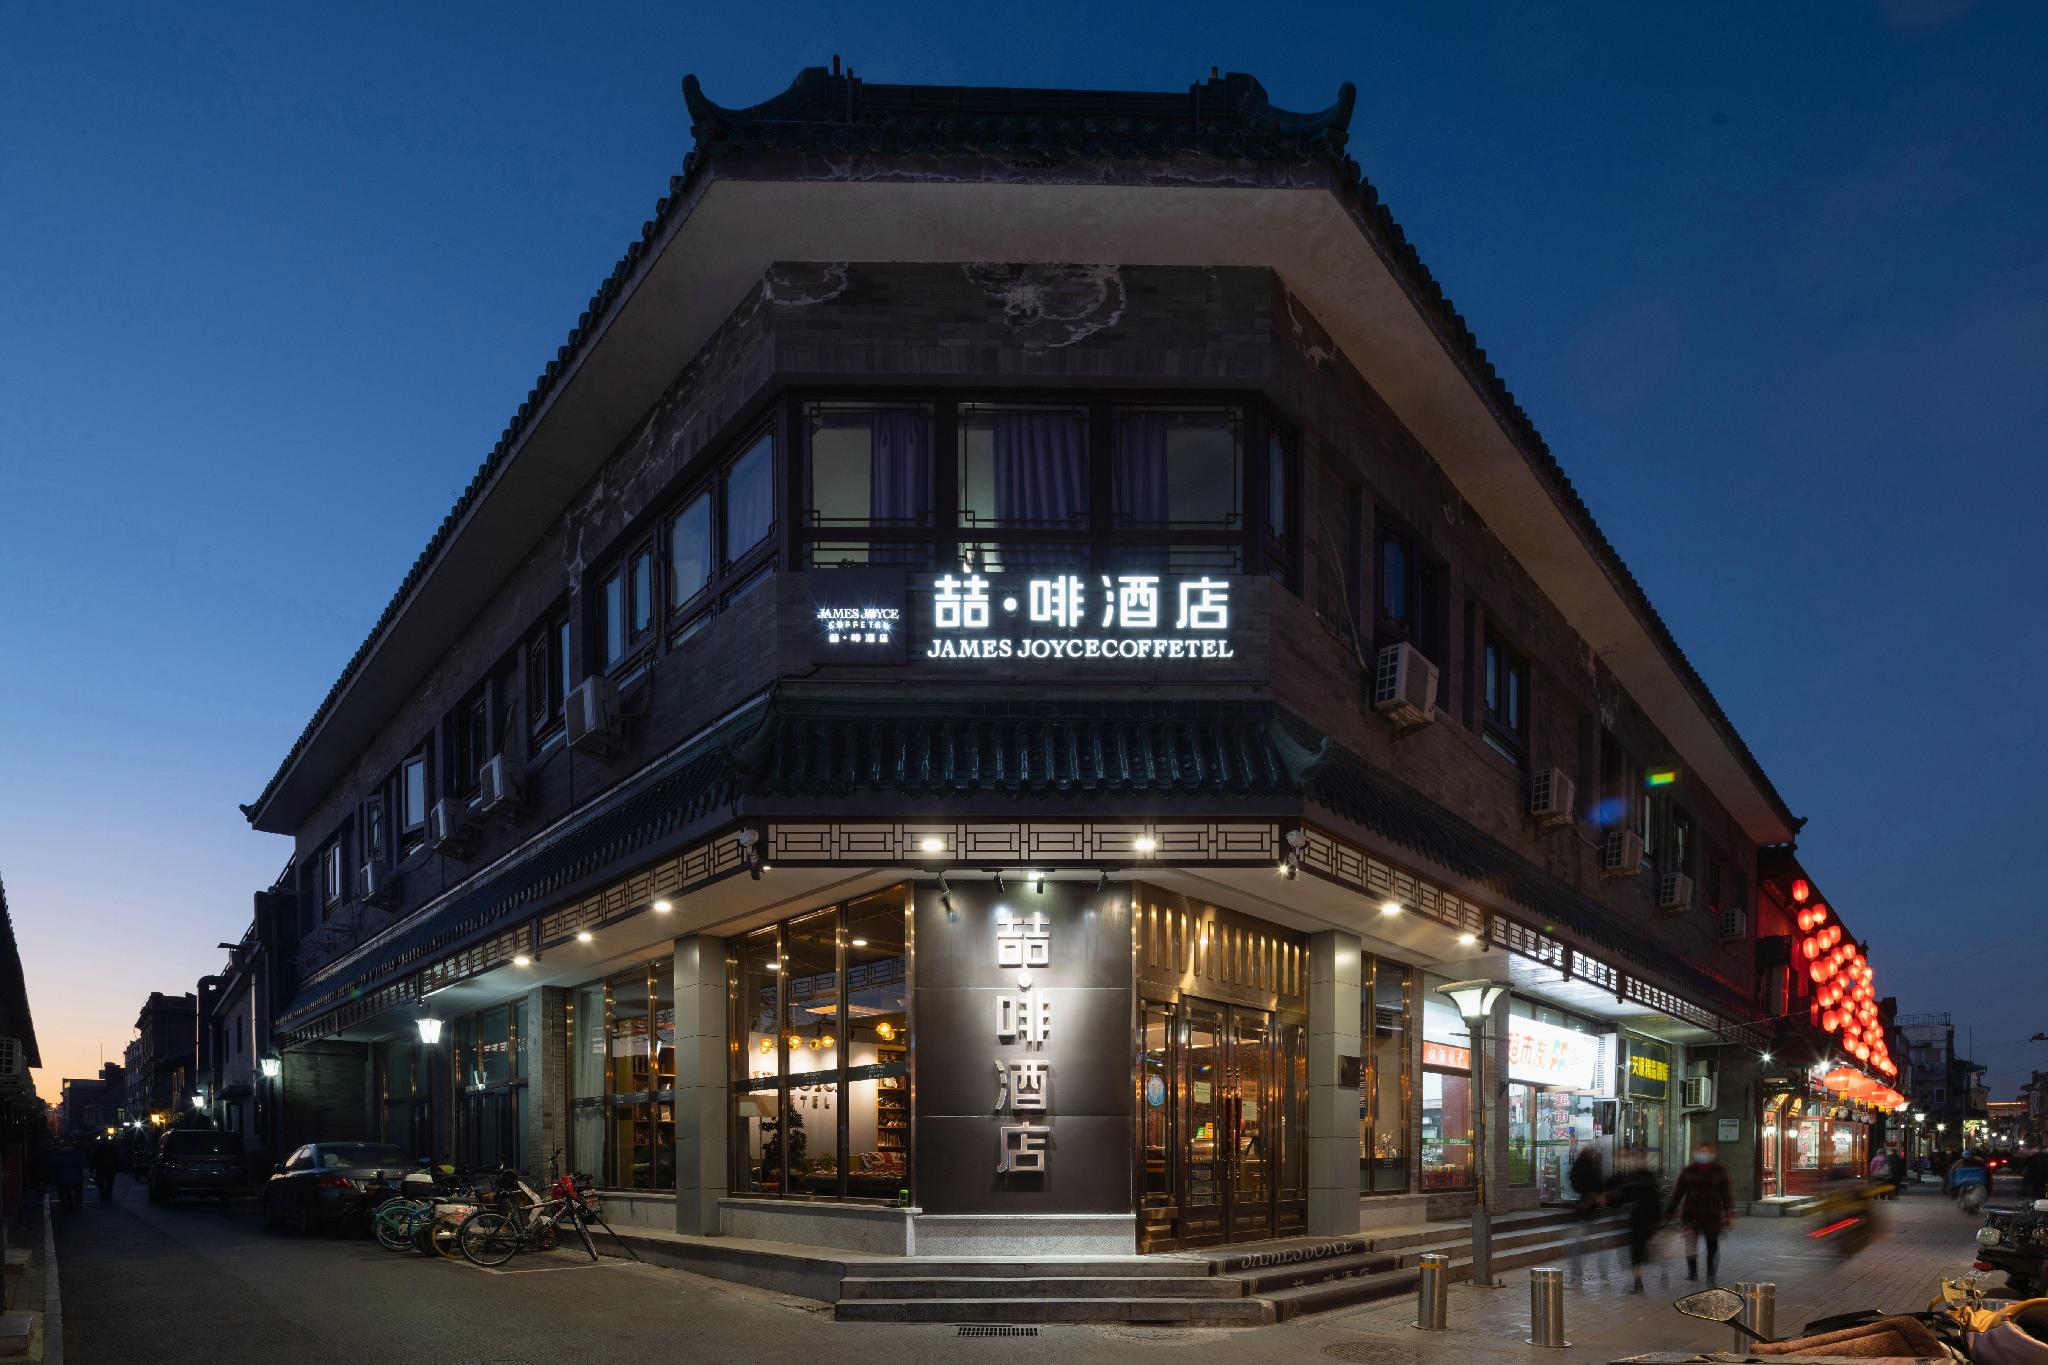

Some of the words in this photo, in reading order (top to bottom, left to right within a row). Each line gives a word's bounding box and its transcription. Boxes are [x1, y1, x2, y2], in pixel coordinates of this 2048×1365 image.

[817, 608, 860, 619] JAMES
[861, 608, 899, 619] JOYCE
[927, 639, 1012, 658] JAMES
